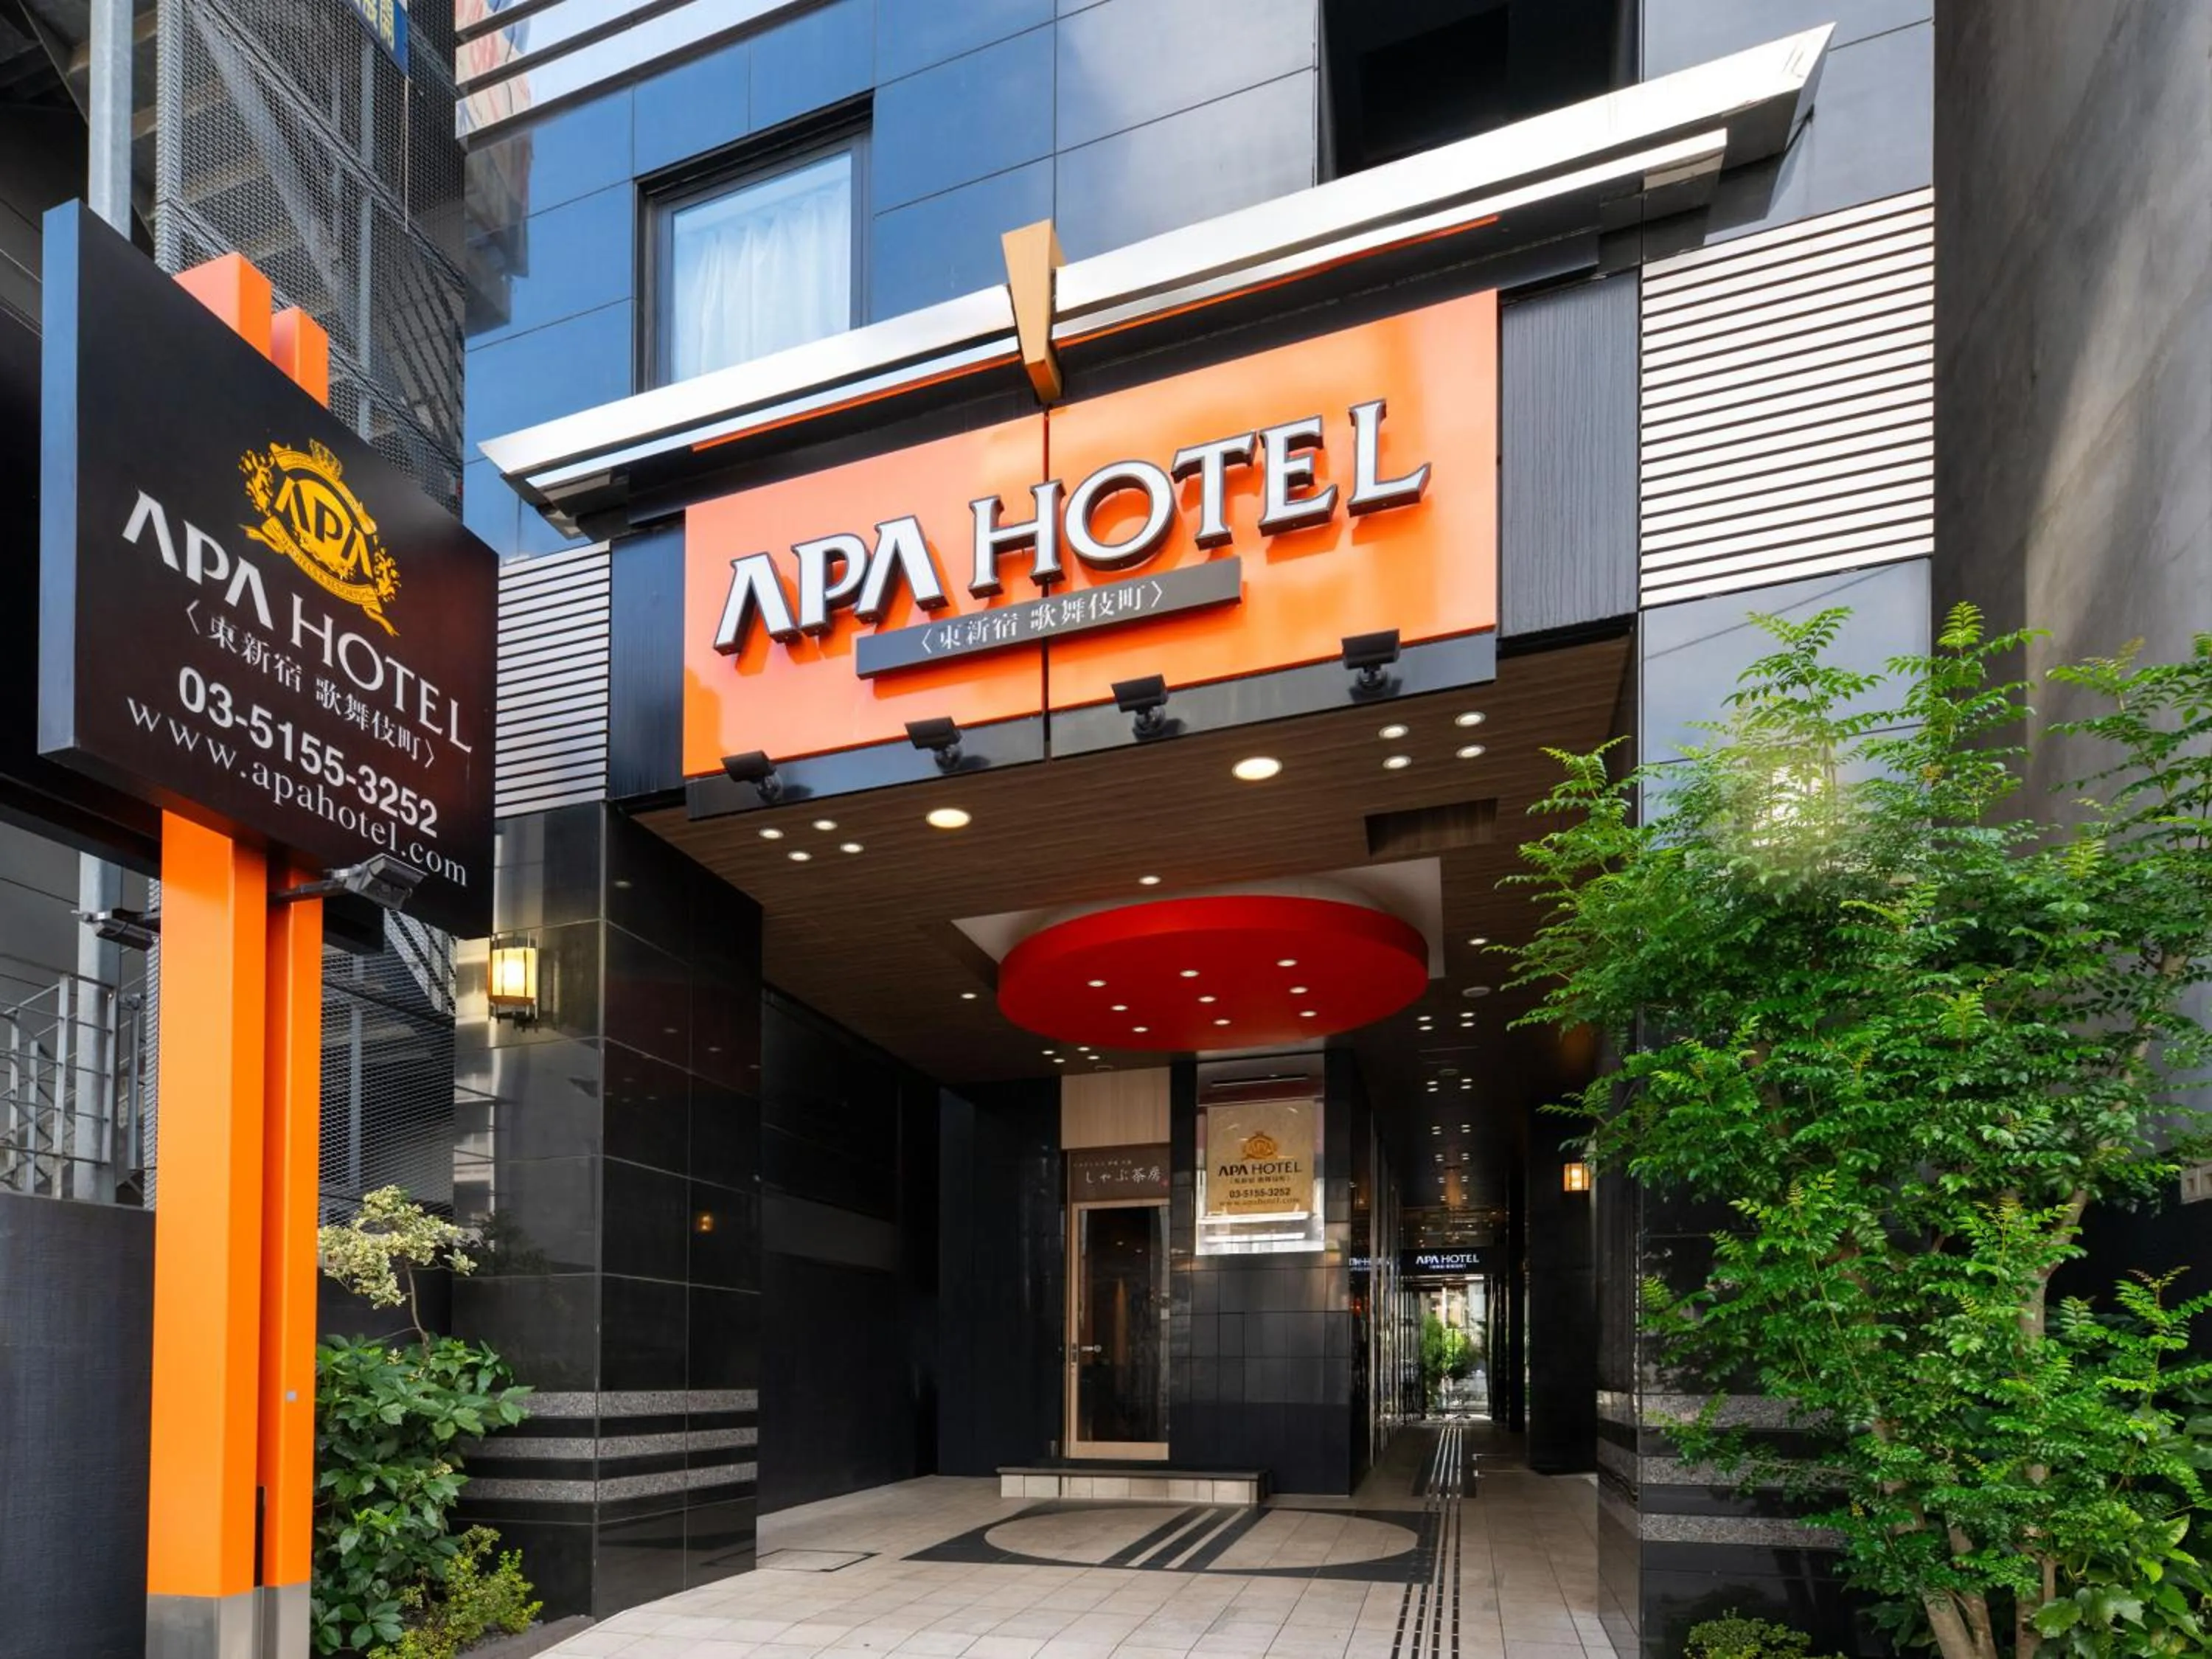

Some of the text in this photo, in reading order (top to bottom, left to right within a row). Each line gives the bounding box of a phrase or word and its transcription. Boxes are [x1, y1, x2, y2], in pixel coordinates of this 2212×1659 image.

[274, 476, 374, 580] APA
[714, 398, 1432, 656] APA HOTEL
[122, 488, 274, 631] APA
[291, 592, 473, 754] HOTEL
[127, 696, 467, 886] www.apahotel.com
[179, 666, 438, 838] 03-5155-3252
[1218, 1161, 1302, 1177] APA HOTEL
[1415, 1253, 1480, 1265] APA HOTEL
